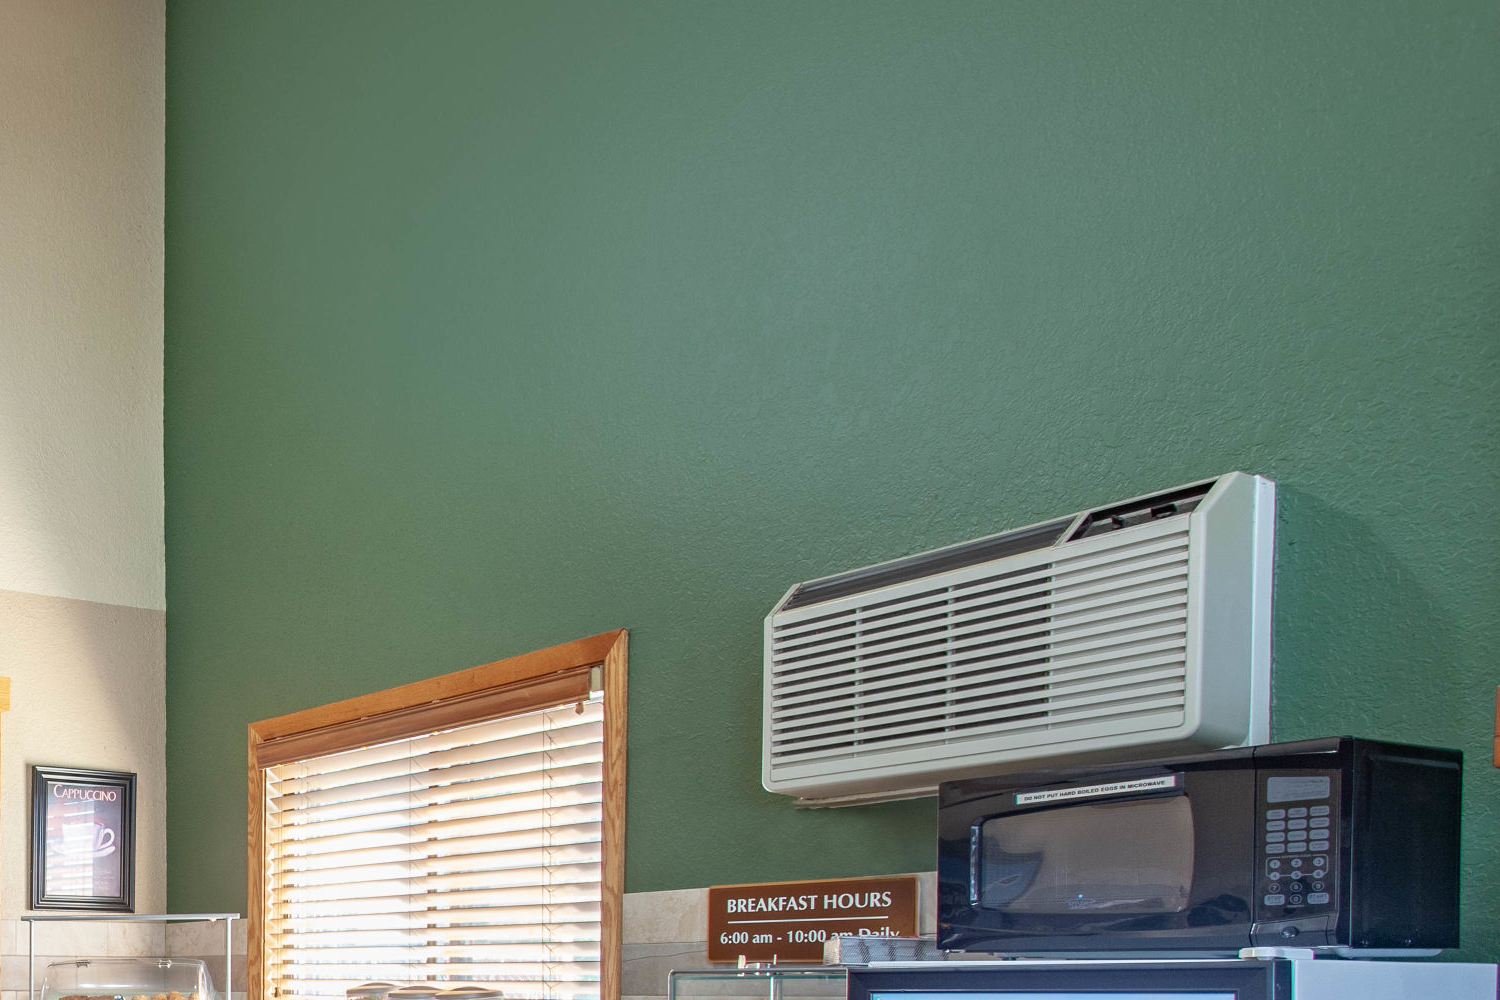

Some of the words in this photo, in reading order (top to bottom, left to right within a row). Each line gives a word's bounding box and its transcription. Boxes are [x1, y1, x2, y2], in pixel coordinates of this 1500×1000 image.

[1127, 780, 1165, 789] MICROWAVE
[727, 895, 818, 913] BREAKFAST
[823, 891, 892, 909] HOURS
[720, 931, 749, 944] 6:00
[752, 933, 773, 943] am
[787, 929, 826, 943] 10:00
